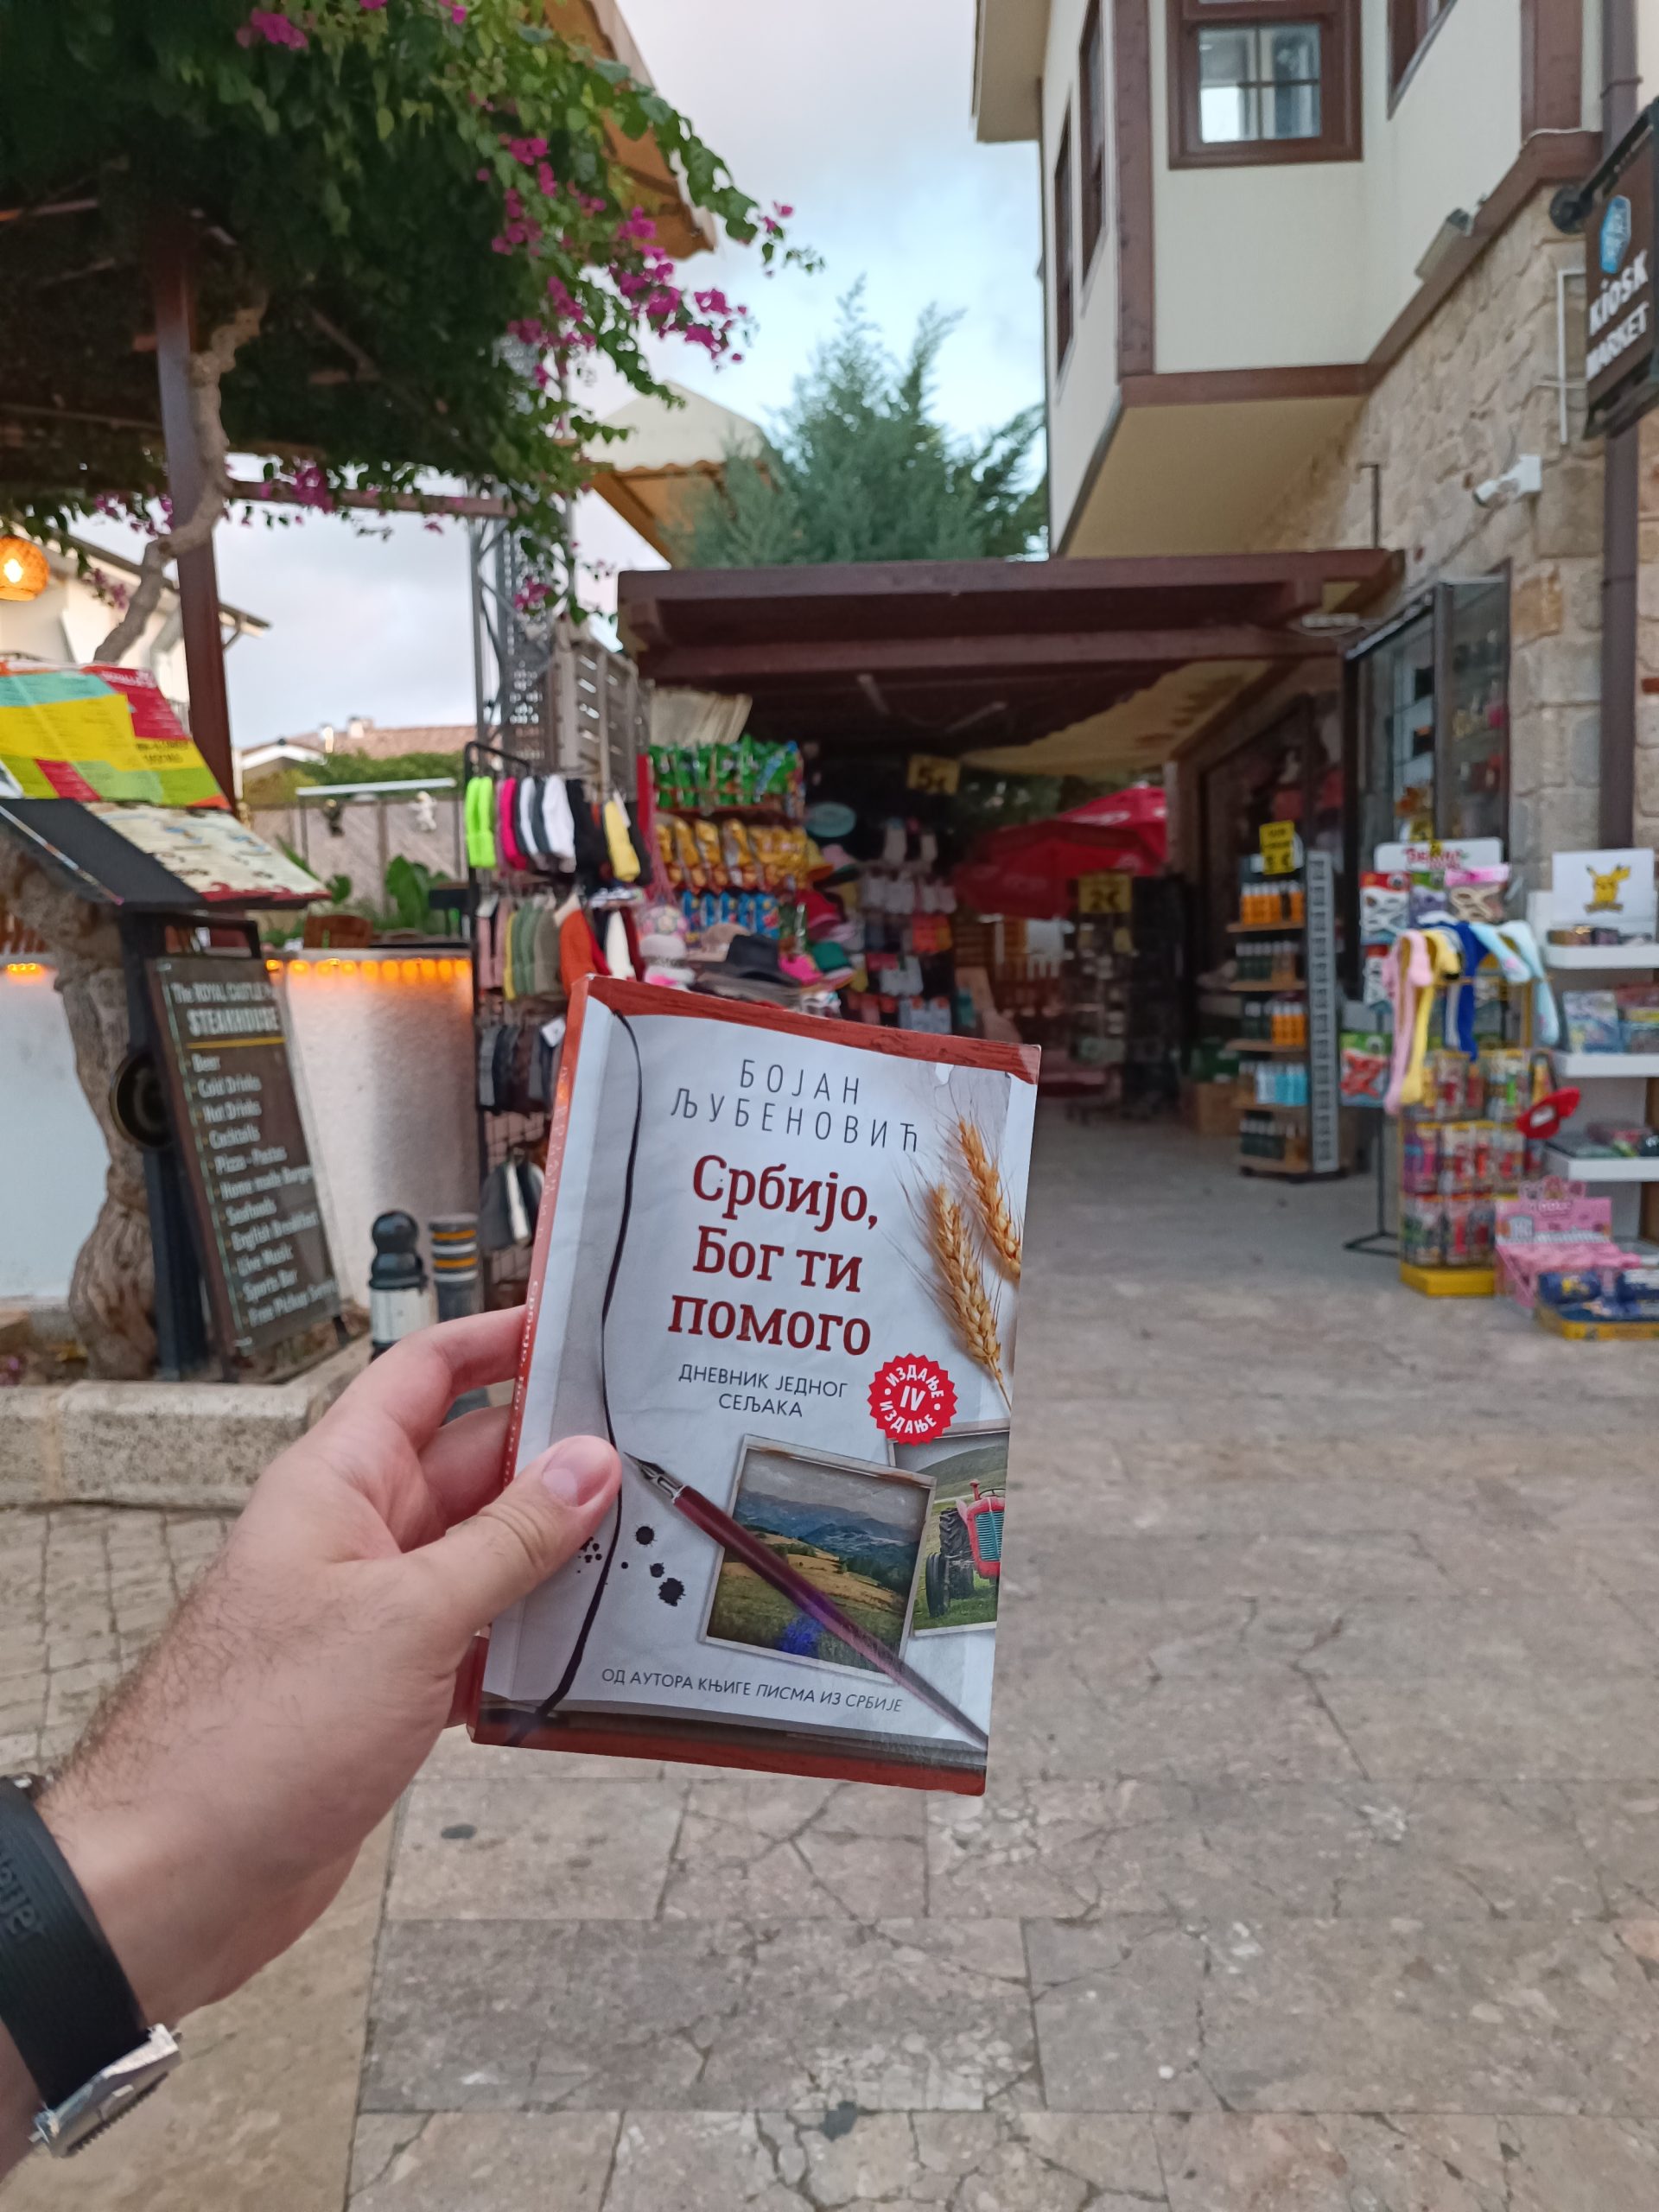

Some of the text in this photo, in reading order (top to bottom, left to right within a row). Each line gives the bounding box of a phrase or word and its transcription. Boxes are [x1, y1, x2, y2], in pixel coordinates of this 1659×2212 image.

[192, 982, 227, 1002] ROYAL
[186, 1005, 279, 1037] STEAKHOUSE
[191, 1052, 221, 1073] Beer
[197, 1072, 262, 1098] Cold Drinks
[740, 1059, 859, 1105] БОЈАН
[202, 1097, 262, 1123] Hot Drinks
[671, 1087, 918, 1153] ЉУБЕНОВИЋ
[208, 1123, 261, 1150] Cocktails
[214, 1153, 247, 1175] Pizza
[219, 1180, 253, 1201] Home
[692, 1154, 878, 1233] Србијо,
[231, 1223, 270, 1251] English
[237, 1242, 294, 1277] Live Music
[692, 1225, 863, 1293] Бог ти
[243, 1268, 298, 1304] Sports Bar
[668, 1294, 871, 1356] помого
[678, 1363, 849, 1398] ДНЕВНИК ЈЕДНОГ
[885, 1364, 944, 1399] ИЗДАЊЕ
[719, 1393, 803, 1417] СЕЉАКА
[899, 1385, 926, 1411] IV
[880, 1400, 938, 1434] ИЗДАЊЕ
[601, 1669, 904, 1713] ОД АУТОРА КЊИГЕ ПИСМА ИЗ СРБИЈЕ
